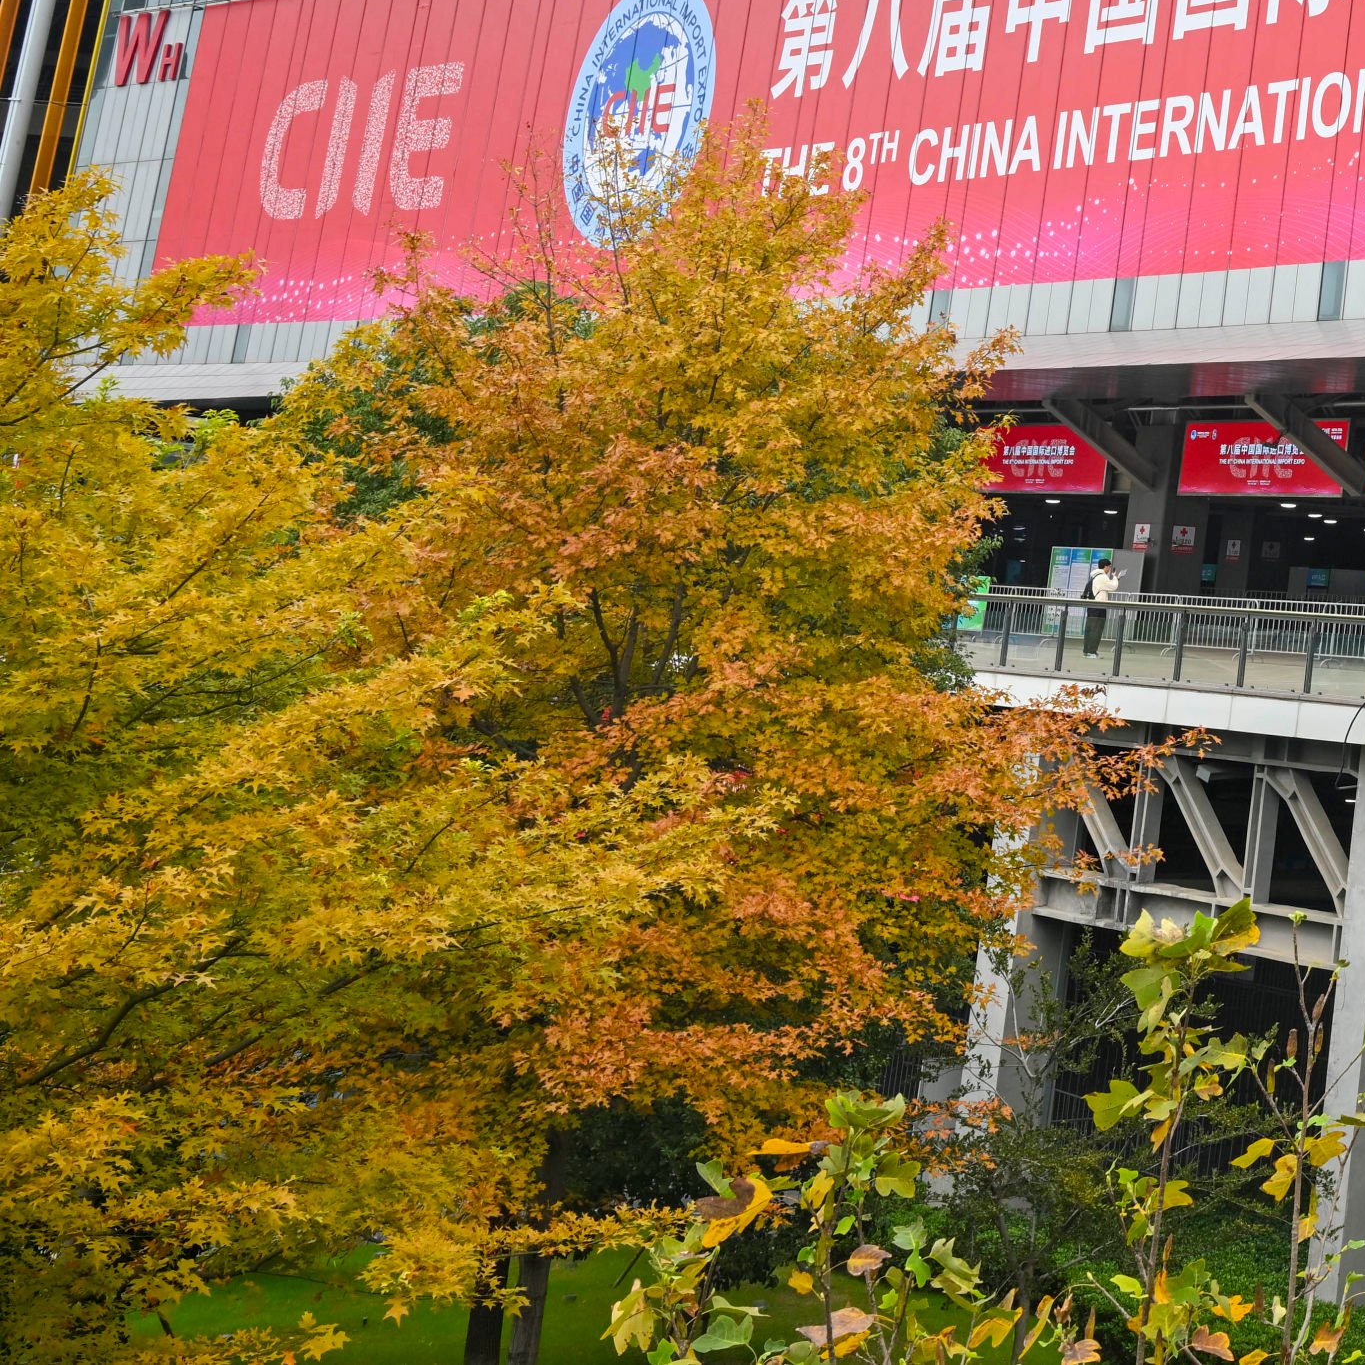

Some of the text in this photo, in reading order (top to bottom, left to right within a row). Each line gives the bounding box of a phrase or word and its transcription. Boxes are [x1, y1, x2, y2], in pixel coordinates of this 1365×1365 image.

[571, 73, 594, 137] CHINA
[679, 1, 706, 58] IMPORT
[694, 66, 708, 123] EXPO
[260, 61, 466, 221] CIIE
[603, 83, 676, 139] CIIE
[842, 129, 900, 192] 8TH
[908, 115, 1041, 186] CHINA
[1219, 443, 1305, 456] 第八届中国国际进口博览
